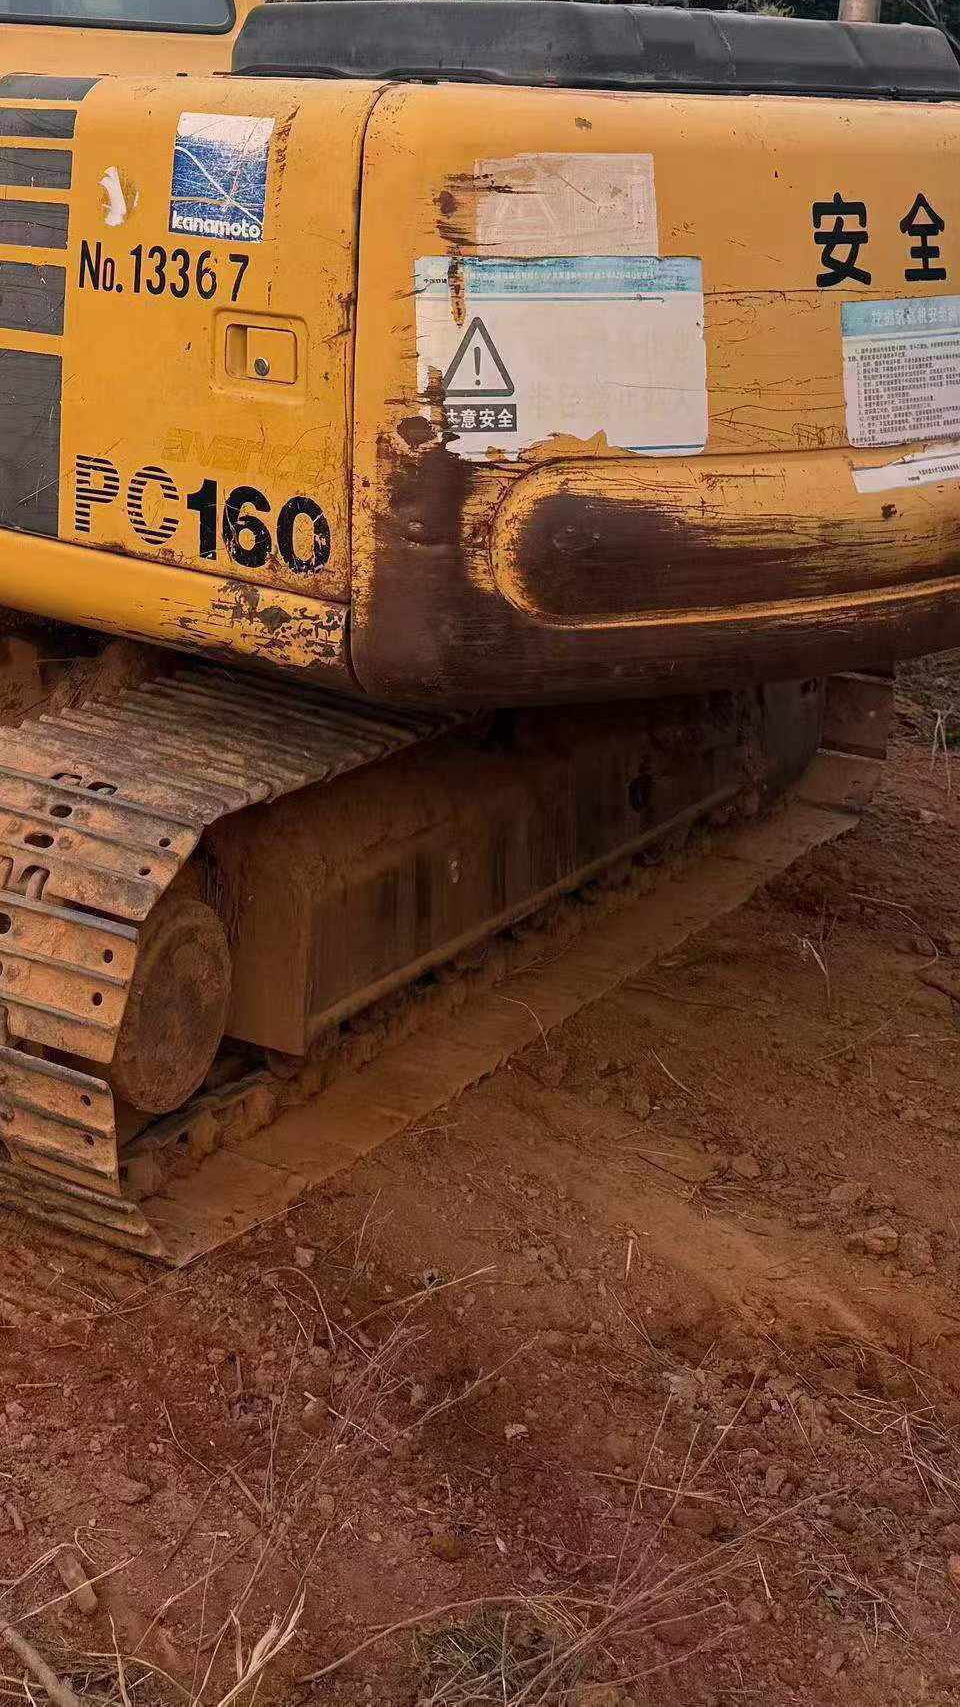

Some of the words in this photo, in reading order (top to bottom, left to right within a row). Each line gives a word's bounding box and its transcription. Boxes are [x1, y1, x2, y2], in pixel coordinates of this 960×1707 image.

[172, 210, 261, 238] kanamoto
[812, 192, 947, 287] 安全
[75, 454, 331, 574] PC160
